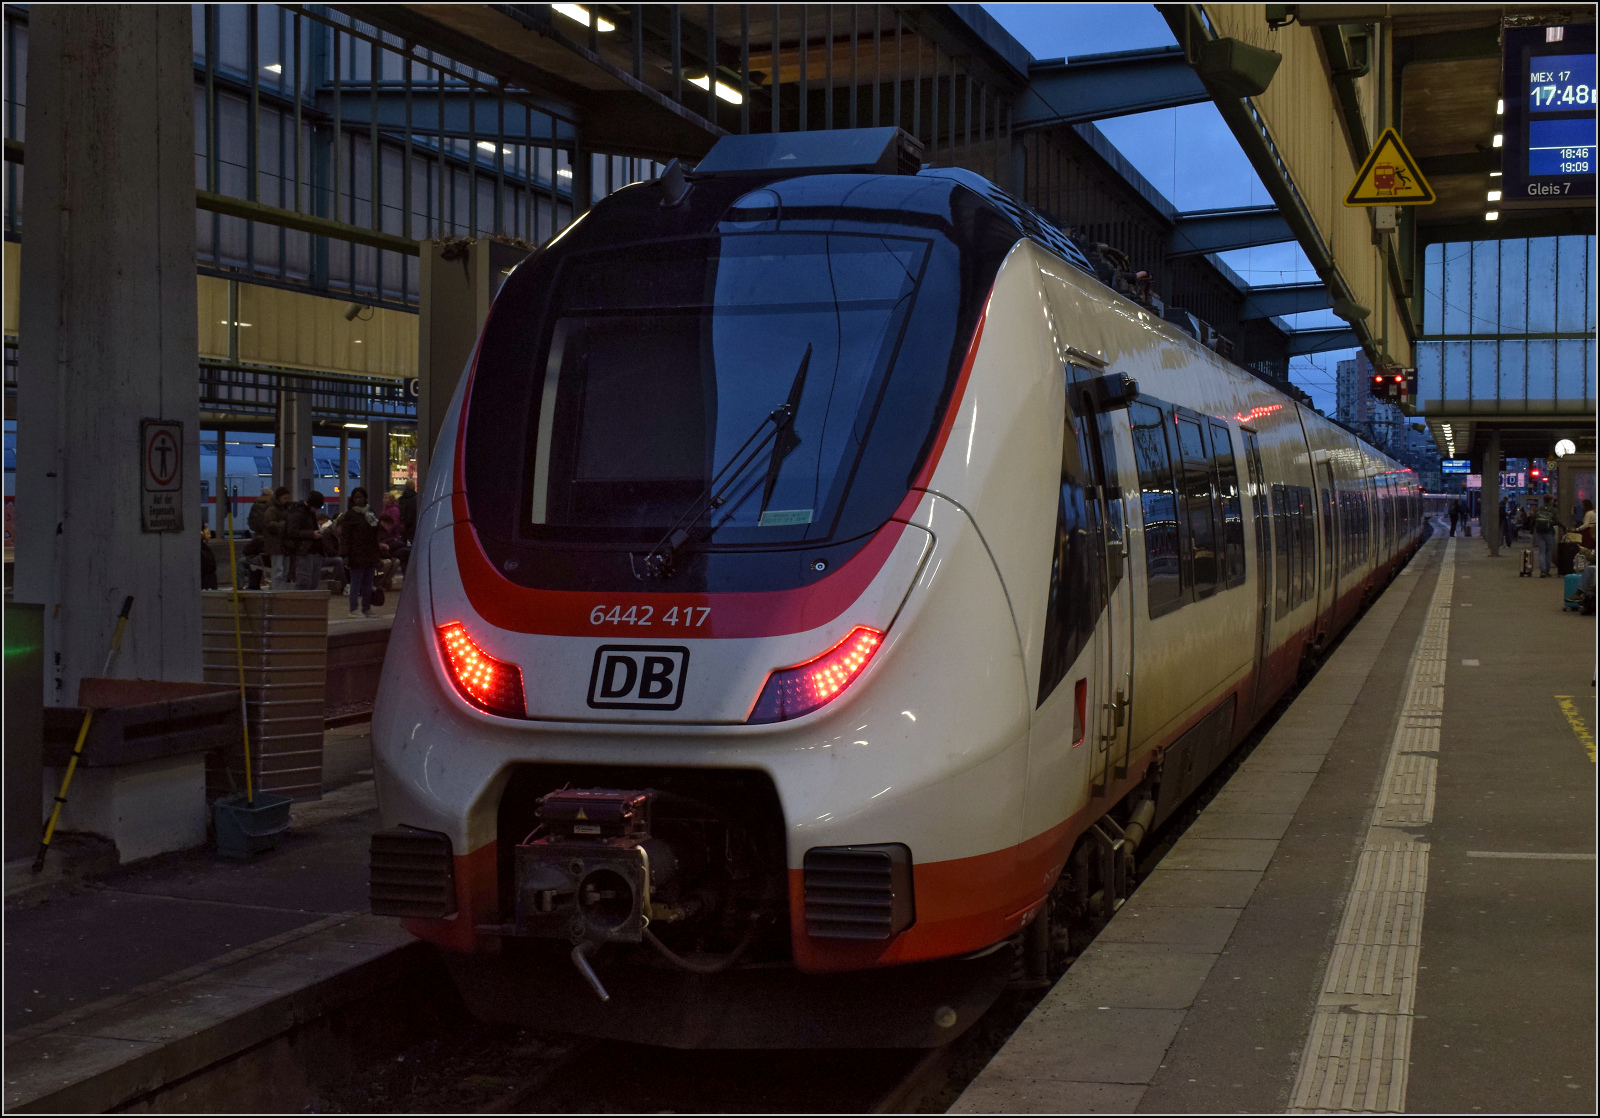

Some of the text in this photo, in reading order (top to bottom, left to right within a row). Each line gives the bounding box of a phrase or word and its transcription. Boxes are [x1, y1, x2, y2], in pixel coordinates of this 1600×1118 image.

[1530, 71, 1571, 83] MEX 17
[1530, 84, 1590, 106] 17:48
[1559, 148, 1589, 159] 18:46
[1559, 161, 1589, 173] 19:09
[1527, 182, 1571, 196] Gleis 7
[589, 604, 711, 627] 6442 417
[598, 653, 677, 701] DB
